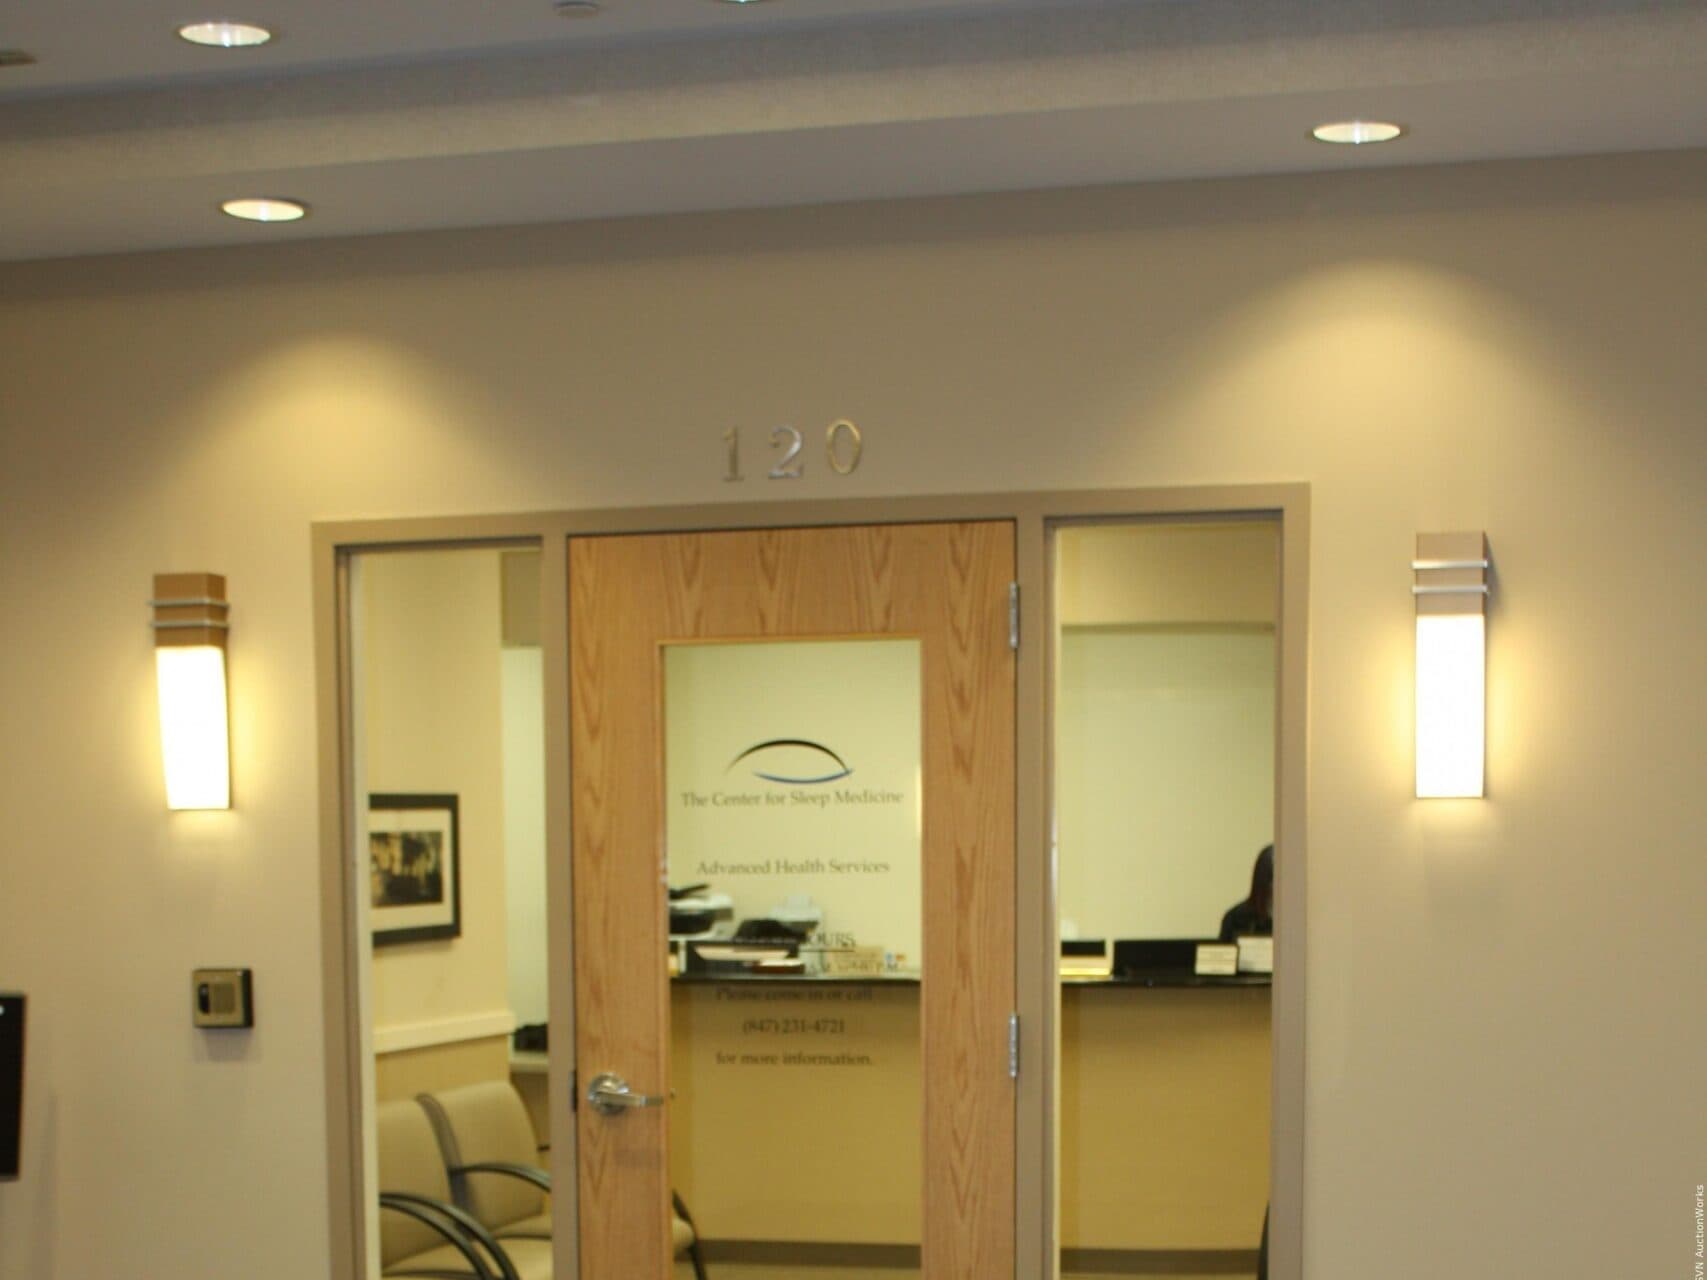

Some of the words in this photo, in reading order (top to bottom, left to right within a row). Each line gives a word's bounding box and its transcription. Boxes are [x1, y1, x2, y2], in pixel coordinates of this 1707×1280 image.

[723, 418, 863, 482] 120
[680, 791, 705, 808] The
[711, 791, 758, 807] Center
[765, 790, 786, 805] for
[790, 790, 831, 809] Sleep
[835, 788, 905, 804] Medicine
[696, 859, 772, 876] Advanced
[775, 858, 825, 875] Health
[829, 858, 890, 874] Services
[716, 1051, 736, 1066] for
[740, 1055, 778, 1066] more
